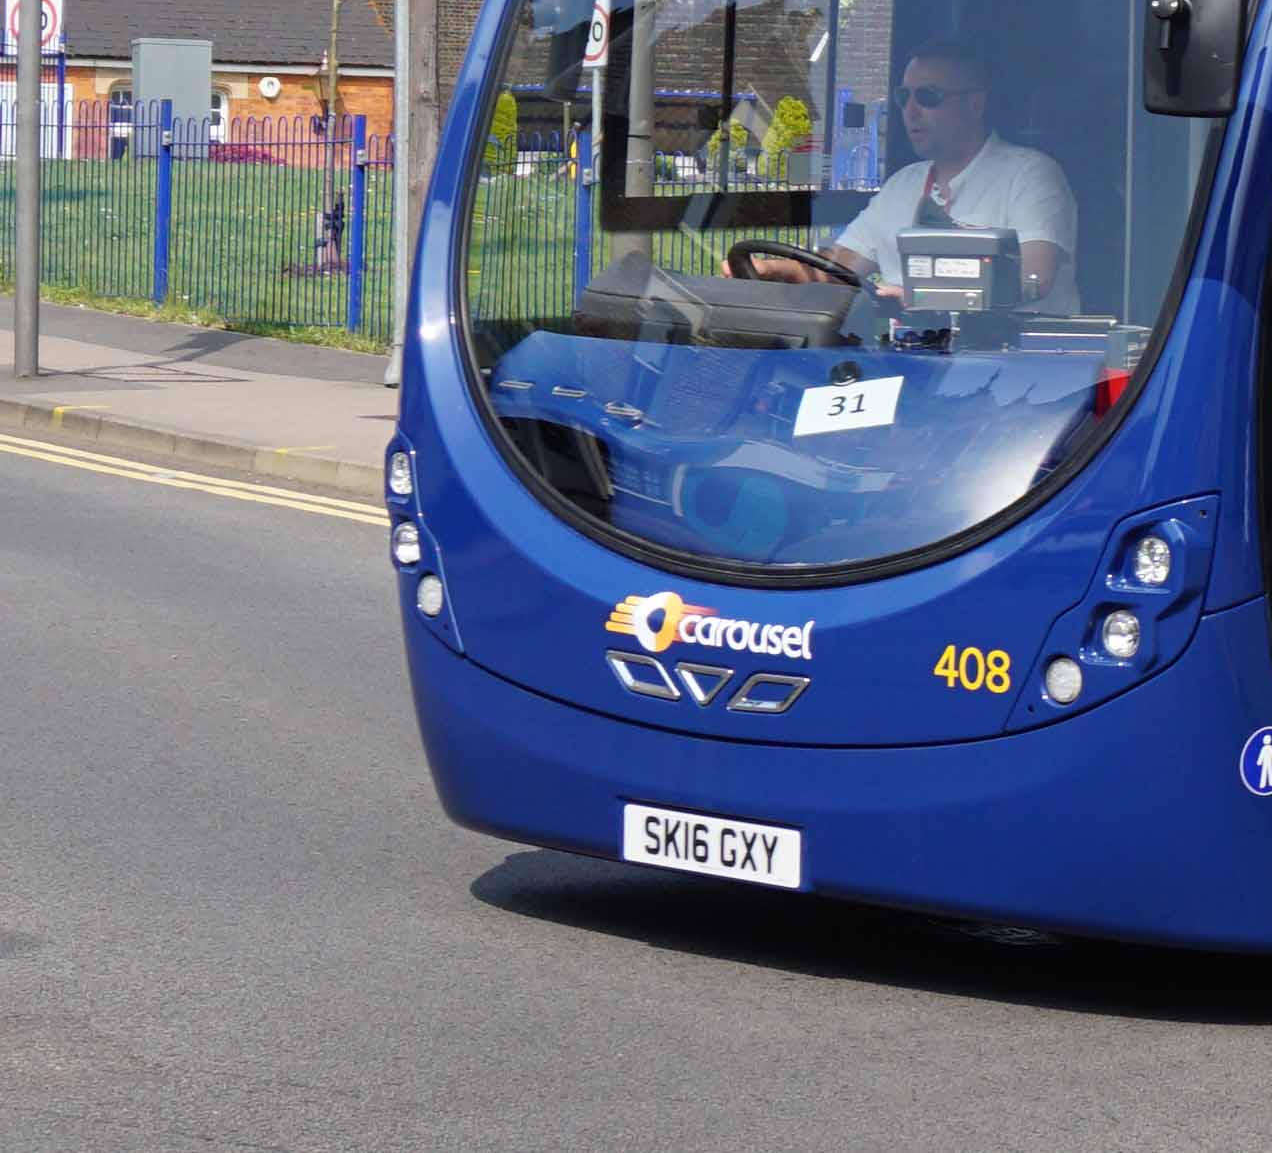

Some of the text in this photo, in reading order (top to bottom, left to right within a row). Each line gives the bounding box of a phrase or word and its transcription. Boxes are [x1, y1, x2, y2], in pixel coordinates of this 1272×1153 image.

[827, 393, 865, 417] 31
[677, 612, 813, 661] carousel
[932, 644, 1011, 694] 408
[644, 816, 778, 875] SK16 GXY
